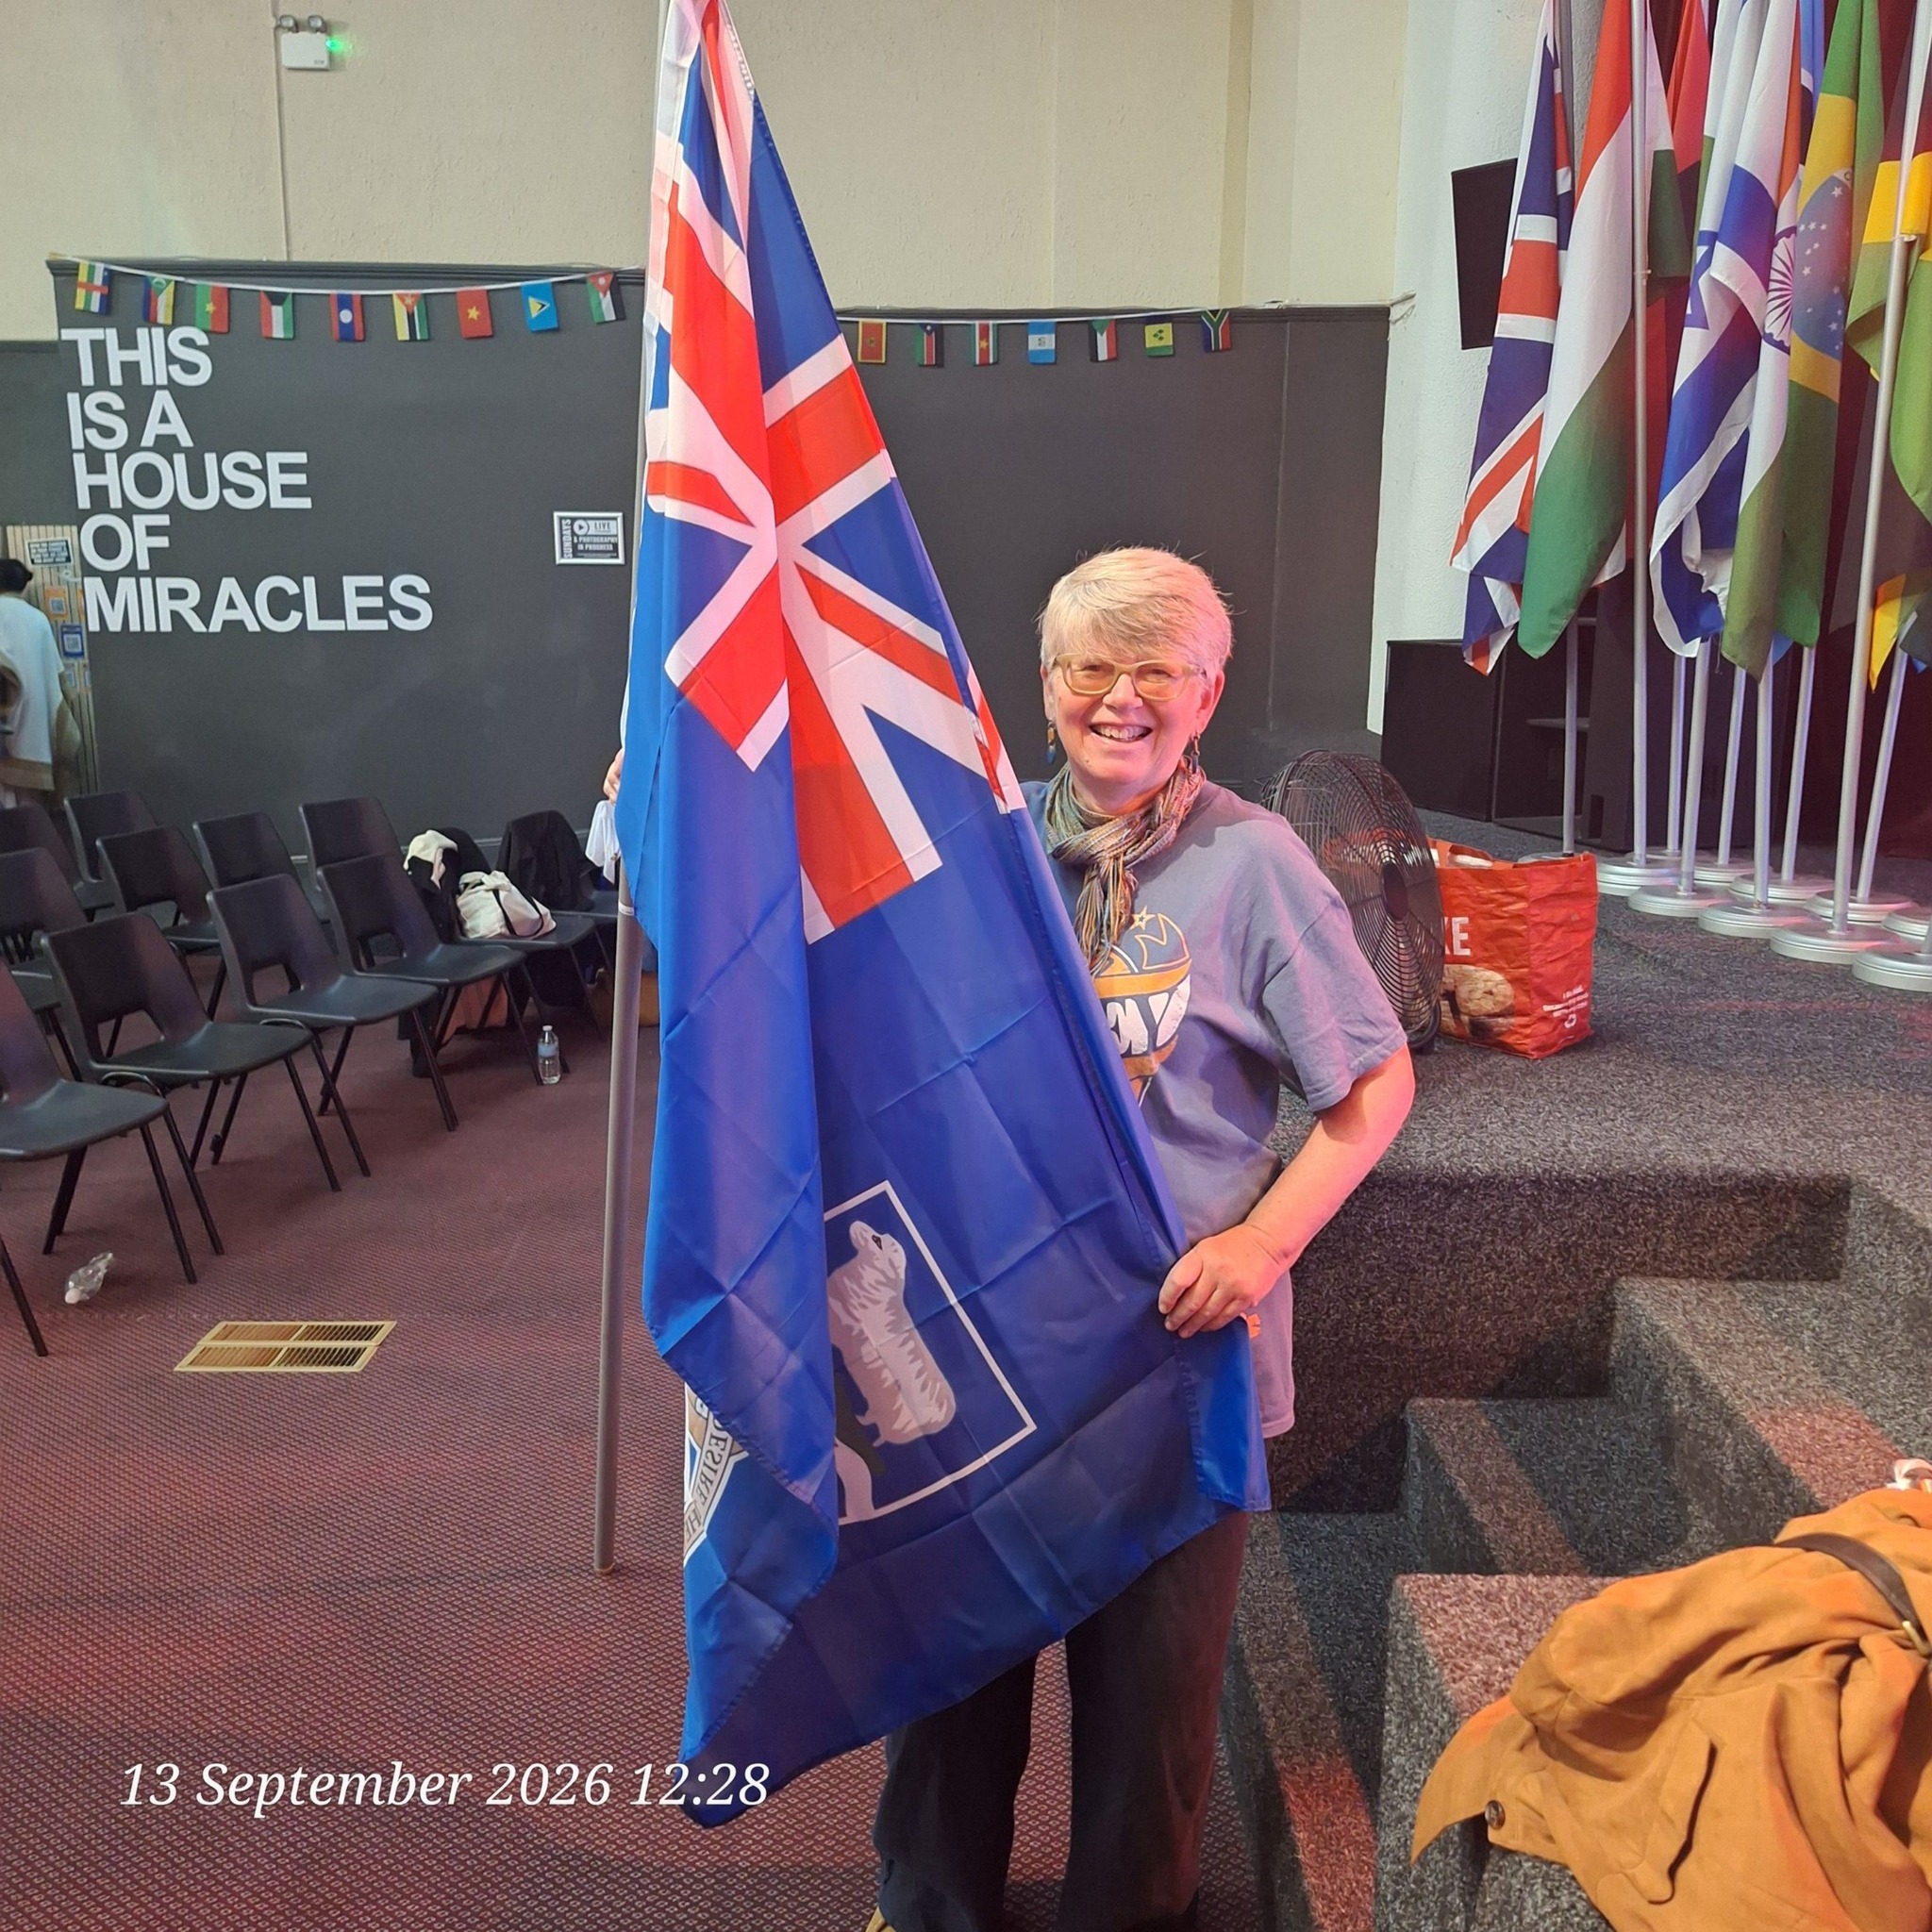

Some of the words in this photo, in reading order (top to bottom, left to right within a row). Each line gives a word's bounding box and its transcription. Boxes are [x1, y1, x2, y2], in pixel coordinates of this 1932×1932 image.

[60, 326, 212, 387] THIS
[67, 391, 128, 450] IS
[141, 390, 193, 447] A
[74, 451, 312, 510] HOUSE
[80, 514, 171, 572] OF
[561, 519, 573, 558] SUNDAYS
[594, 522, 610, 530] LIVE
[84, 575, 433, 633] MIRACLES
